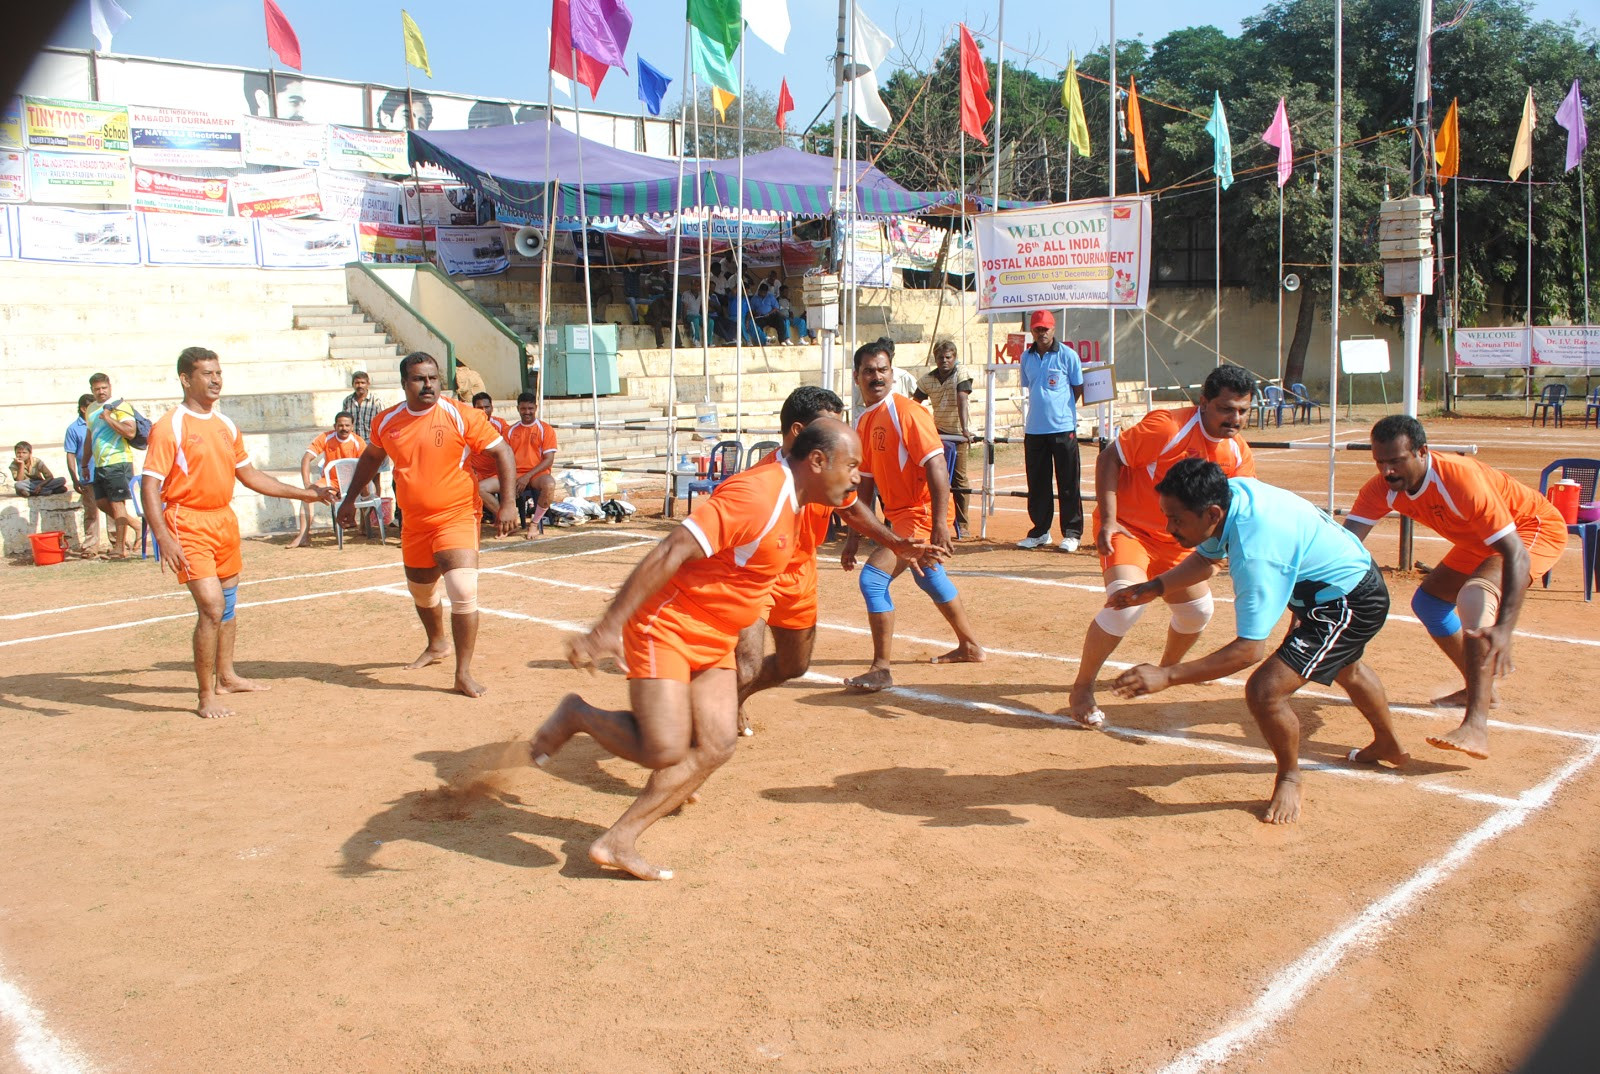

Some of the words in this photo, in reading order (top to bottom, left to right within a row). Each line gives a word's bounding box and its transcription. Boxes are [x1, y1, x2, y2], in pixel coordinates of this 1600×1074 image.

[28, 107, 85, 129] TINYTOTS
[134, 114, 173, 123] KABADDI
[176, 116, 235, 126] TOURNAMENT
[103, 123, 128, 140] School
[1008, 218, 1107, 239] WELCOME
[1017, 241, 1040, 255] 26th
[1043, 239, 1066, 252] ALL
[1069, 237, 1100, 250] INDIA
[982, 257, 1022, 271] POSTAL
[1024, 254, 1069, 268] KABADDI
[1071, 251, 1134, 265] TOURNAMENT
[1005, 274, 1026, 282] From
[1041, 271, 1049, 279] to
[1002, 294, 1026, 304] RAIL
[1027, 292, 1068, 303] STADIUM,
[1070, 291, 1110, 301] VIJAYAWADA
[1467, 331, 1517, 339] WELCOME
[1548, 329, 1600, 337] WELCOME
[434, 429, 444, 448] 8
[872, 431, 886, 451] 12
